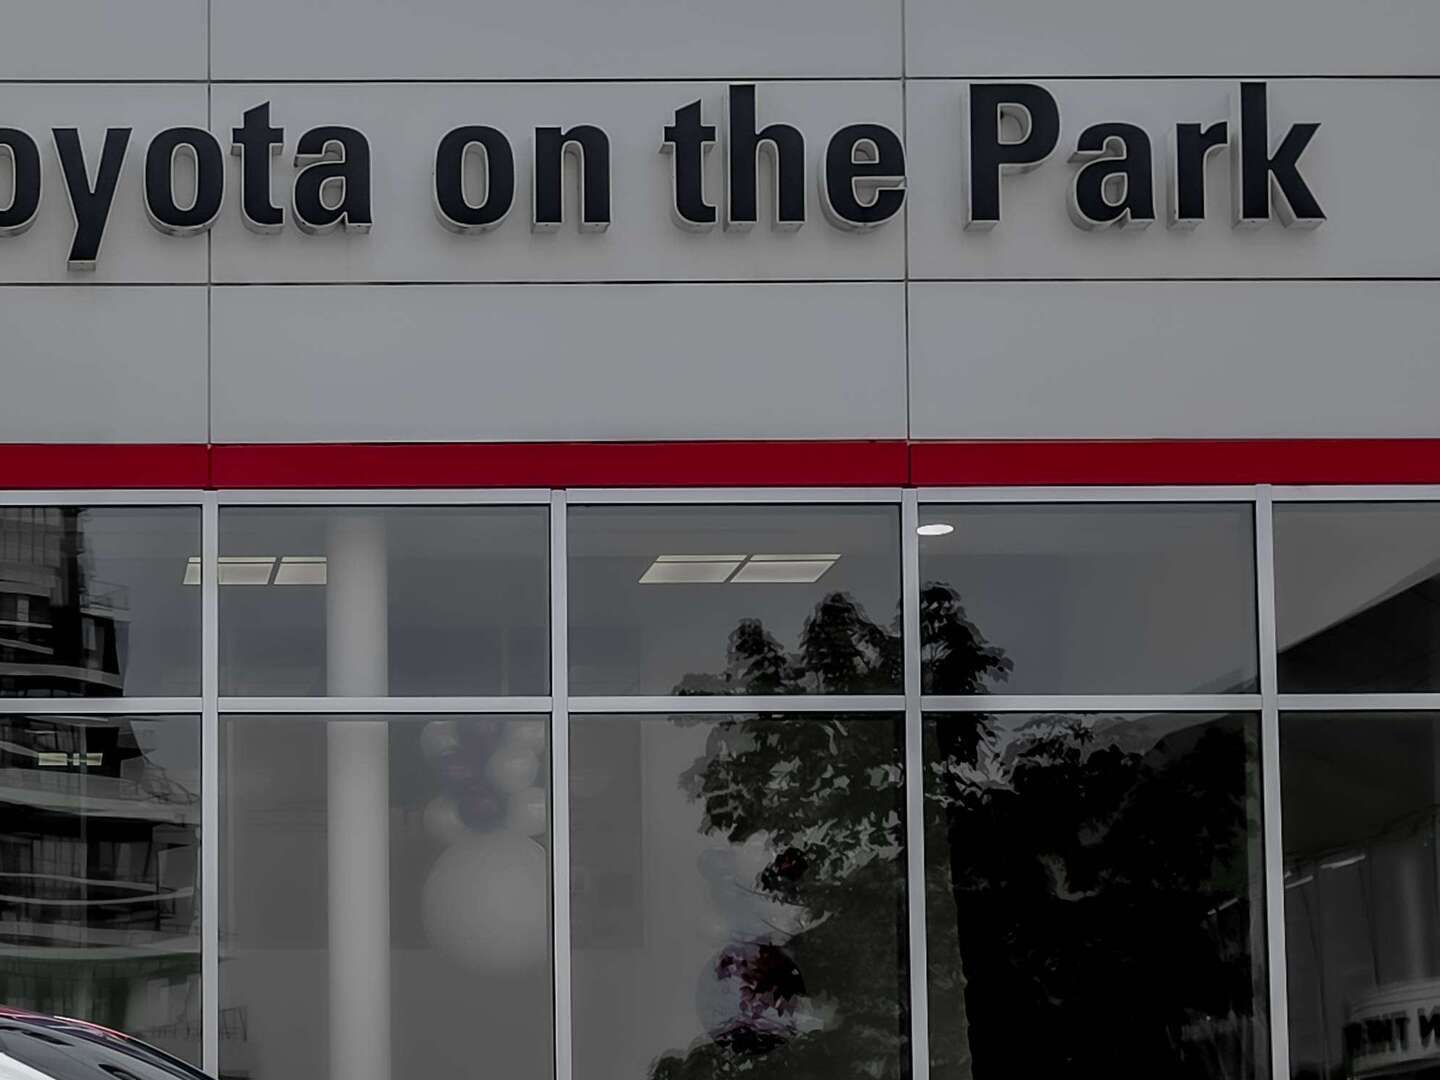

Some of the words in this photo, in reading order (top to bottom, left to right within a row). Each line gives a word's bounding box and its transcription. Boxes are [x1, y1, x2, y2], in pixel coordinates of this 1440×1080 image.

[434, 124, 612, 233] on
[660, 83, 907, 232] the
[963, 82, 1326, 232] Park
